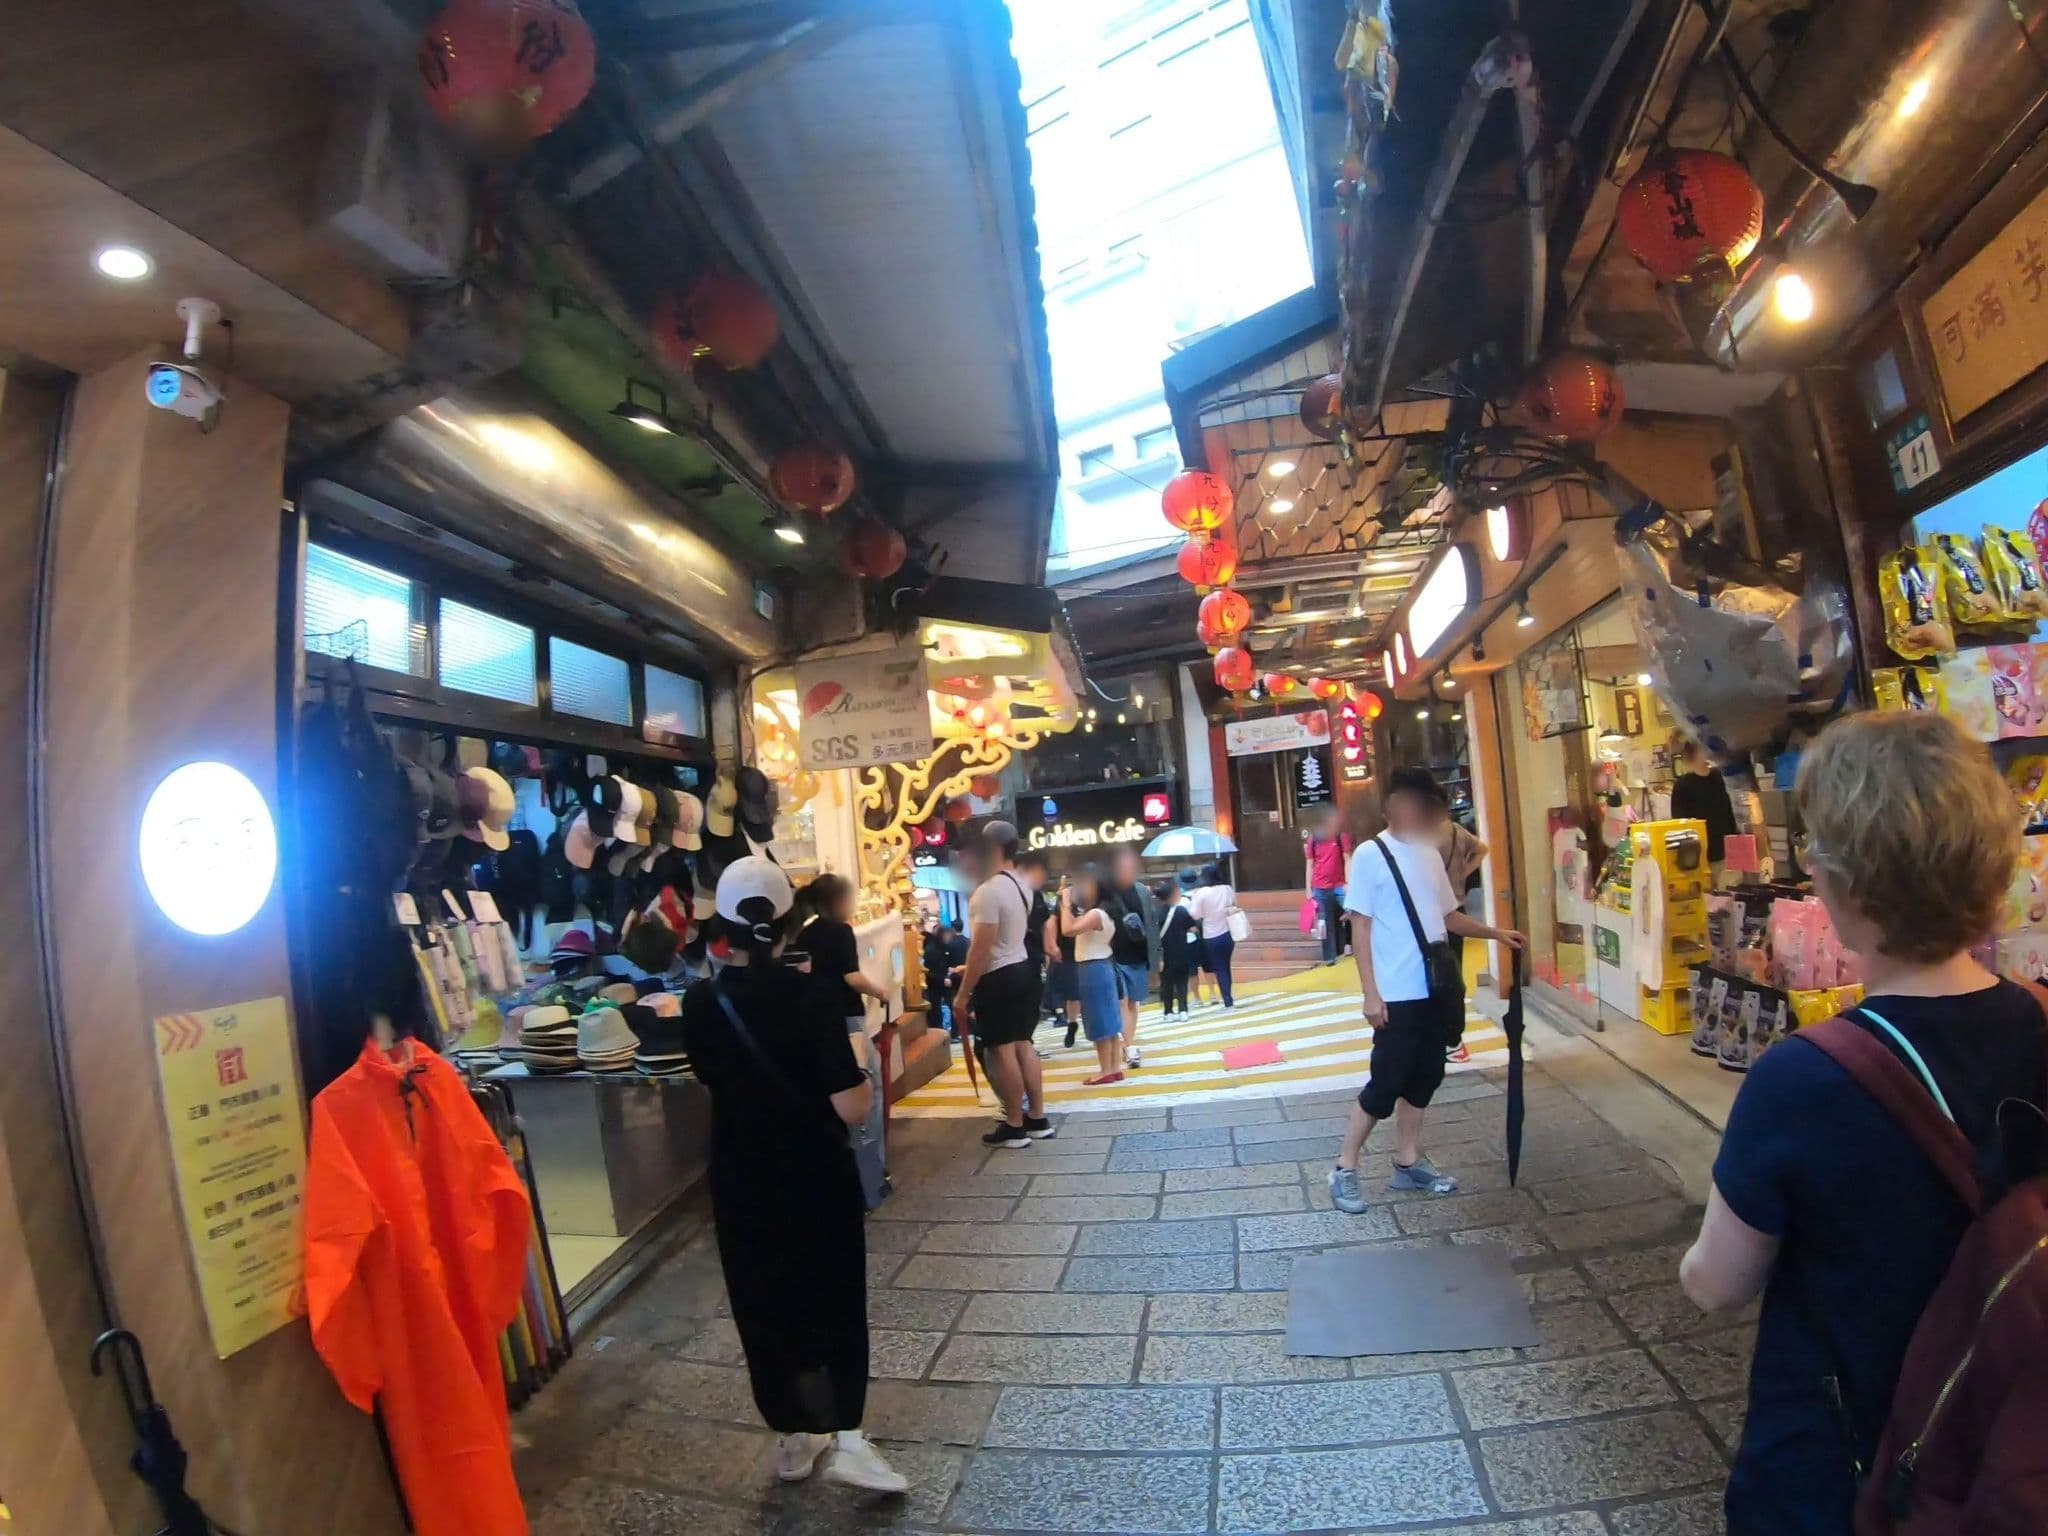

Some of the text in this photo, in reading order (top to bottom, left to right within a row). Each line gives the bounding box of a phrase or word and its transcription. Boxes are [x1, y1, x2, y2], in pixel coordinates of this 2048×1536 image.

[811, 734, 859, 762] SGS
[1029, 817, 1146, 849] Golden Cafe
